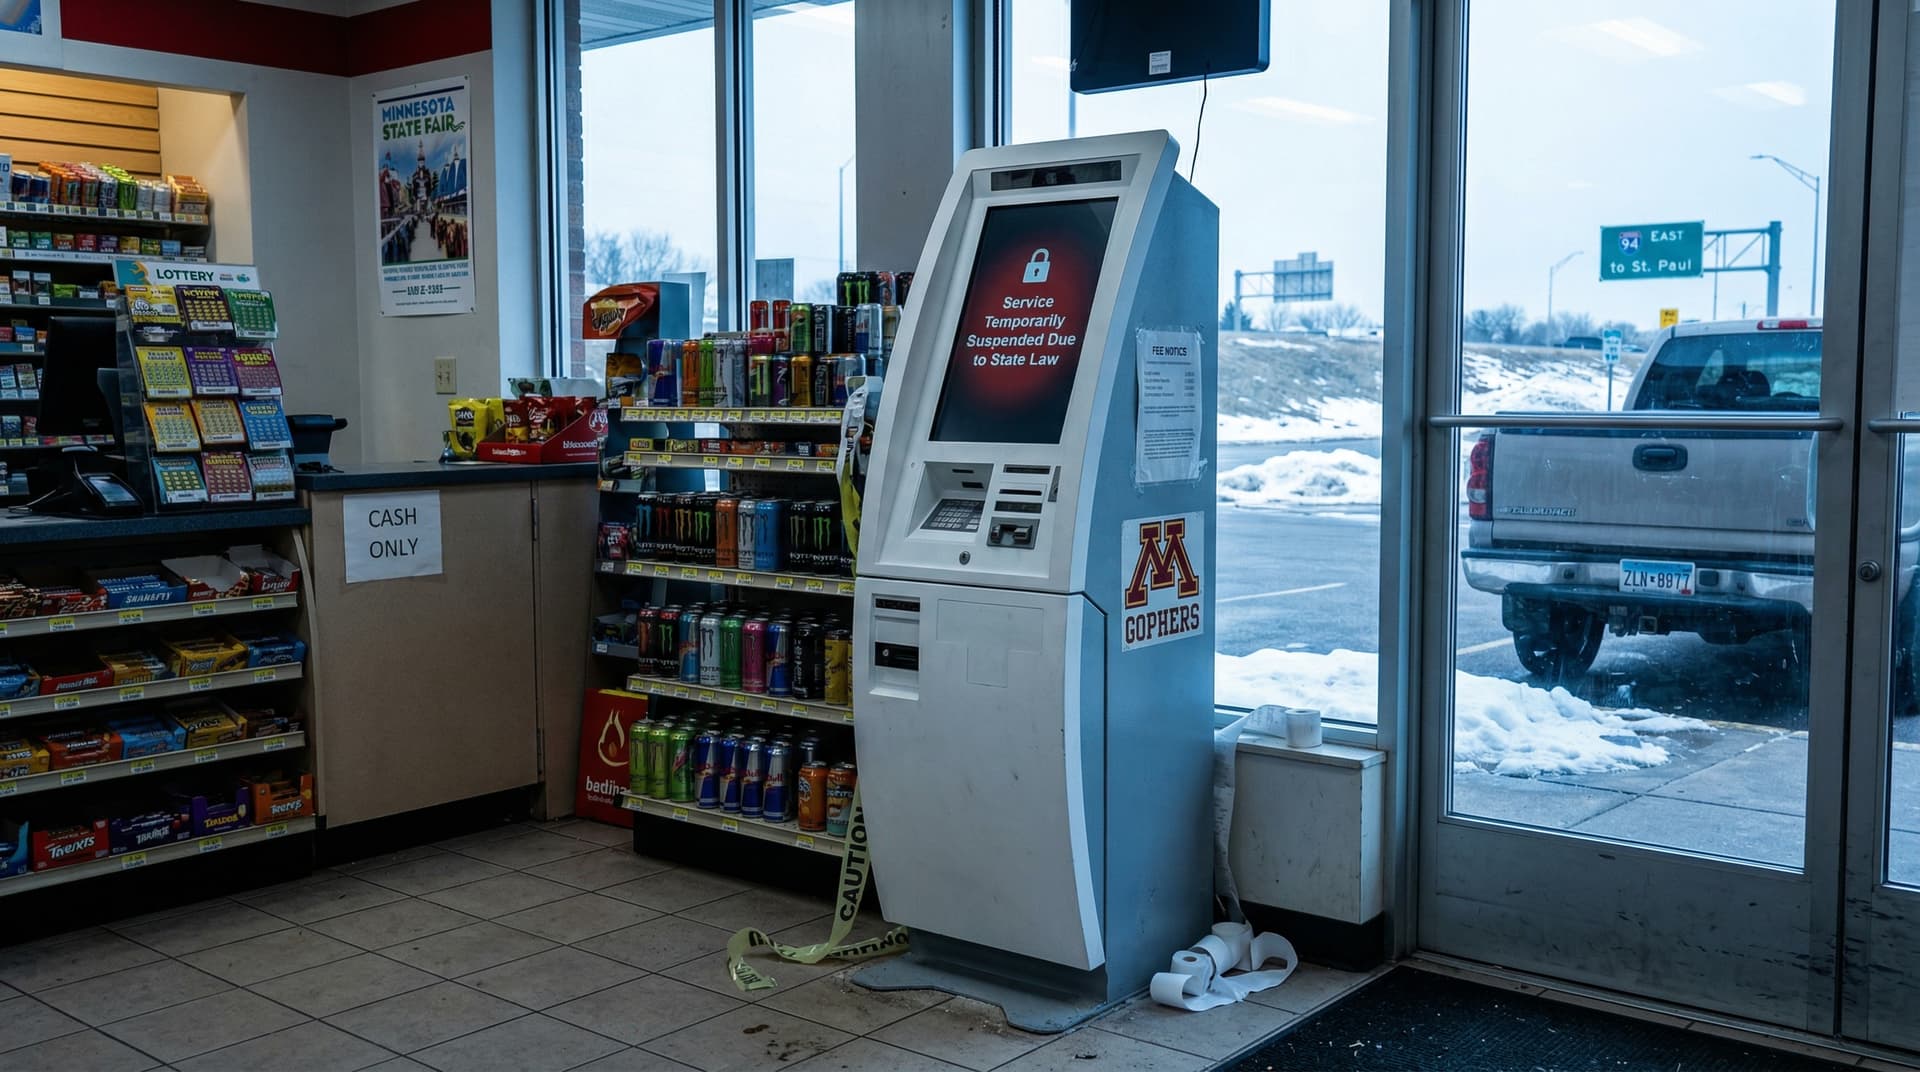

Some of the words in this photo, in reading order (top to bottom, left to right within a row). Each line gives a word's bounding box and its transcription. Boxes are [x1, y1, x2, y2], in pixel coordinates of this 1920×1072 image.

[382, 95, 455, 122] MINNESOTA
[383, 118, 422, 140] STATE
[424, 113, 459, 134] FAIR
[1621, 239, 1639, 250] 94
[1651, 230, 1685, 242] EAST
[156, 268, 214, 281] LOTTERY
[1610, 261, 1625, 273] to
[1632, 260, 1651, 273] St.
[1658, 259, 1692, 271] Paul
[1002, 296, 1054, 309] Service
[985, 314, 1066, 331] Temporarily
[966, 333, 1044, 350] Suspended
[1047, 333, 1076, 346] Due
[973, 355, 987, 366] to
[990, 352, 1026, 366] State
[1030, 353, 1059, 366] Law
[1152, 346, 1164, 356] FEE
[368, 507, 417, 528] CASH
[369, 537, 419, 558] ONLY
[1125, 518, 1199, 610] M
[1125, 603, 1200, 644] GOPHERS
